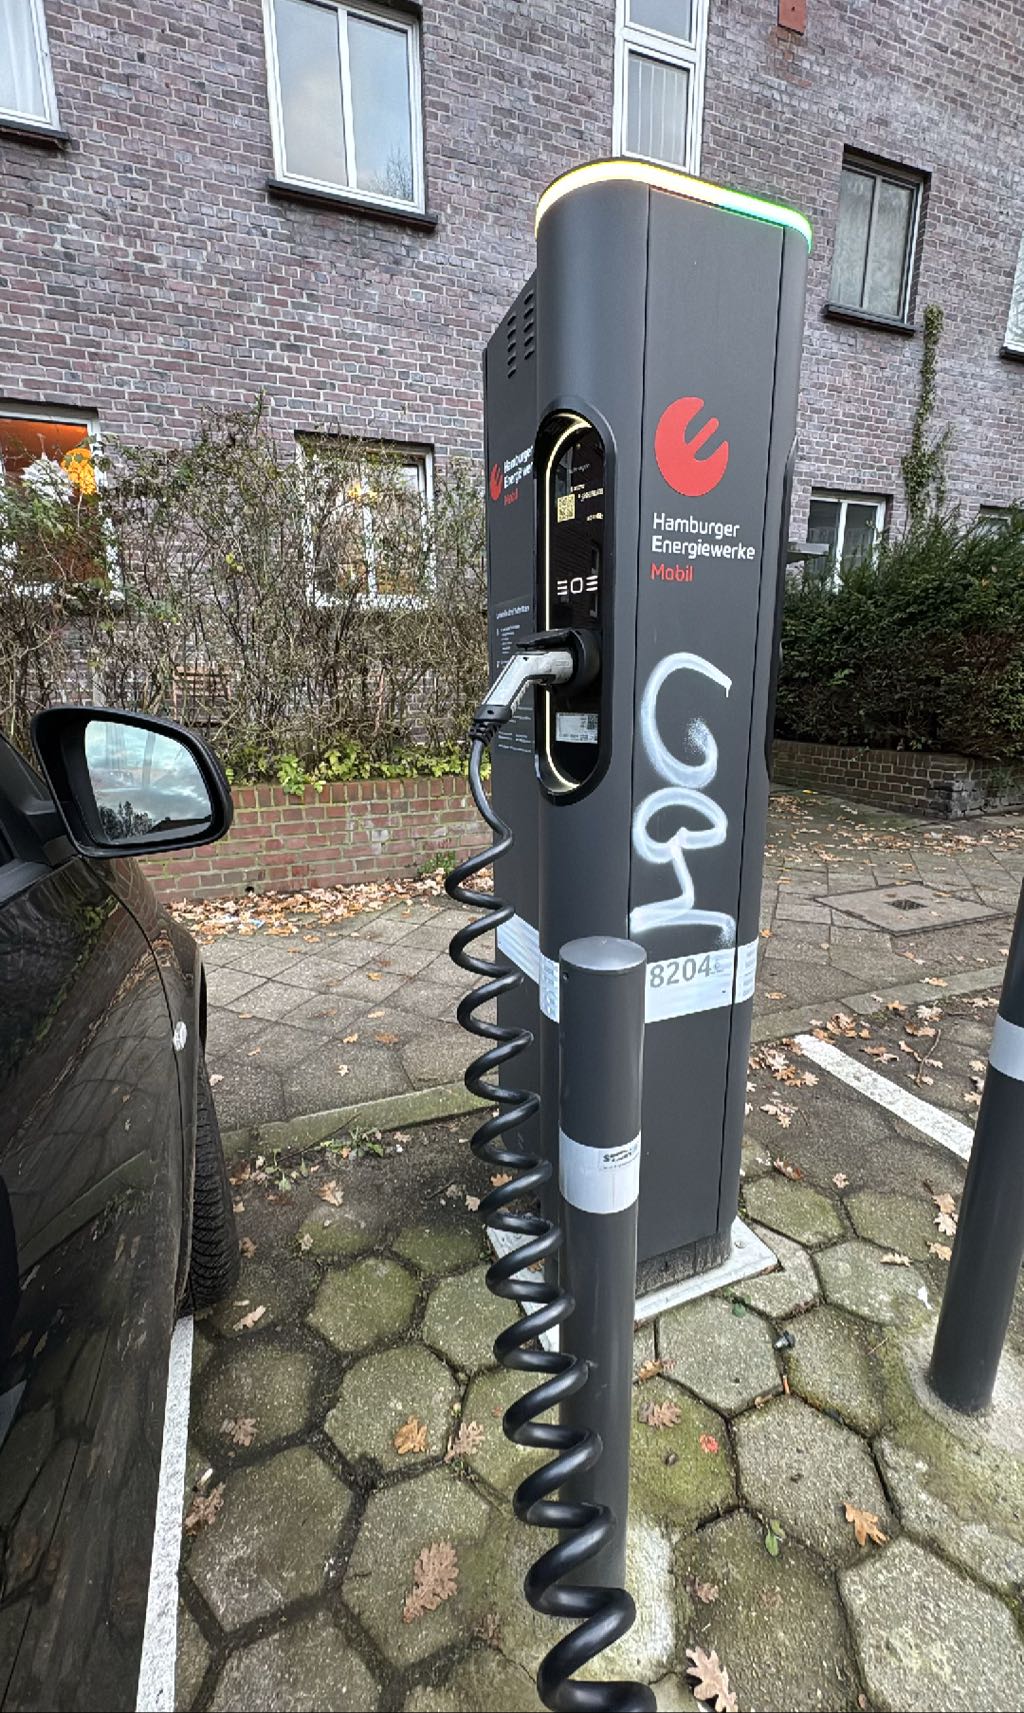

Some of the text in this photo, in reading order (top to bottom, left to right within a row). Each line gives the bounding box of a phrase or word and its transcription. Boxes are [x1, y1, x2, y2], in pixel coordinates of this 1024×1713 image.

[653, 512, 740, 540] Hamburger
[651, 535, 756, 560] Energiewerke
[651, 562, 694, 582] Mobil
[649, 954, 712, 988] 8204
